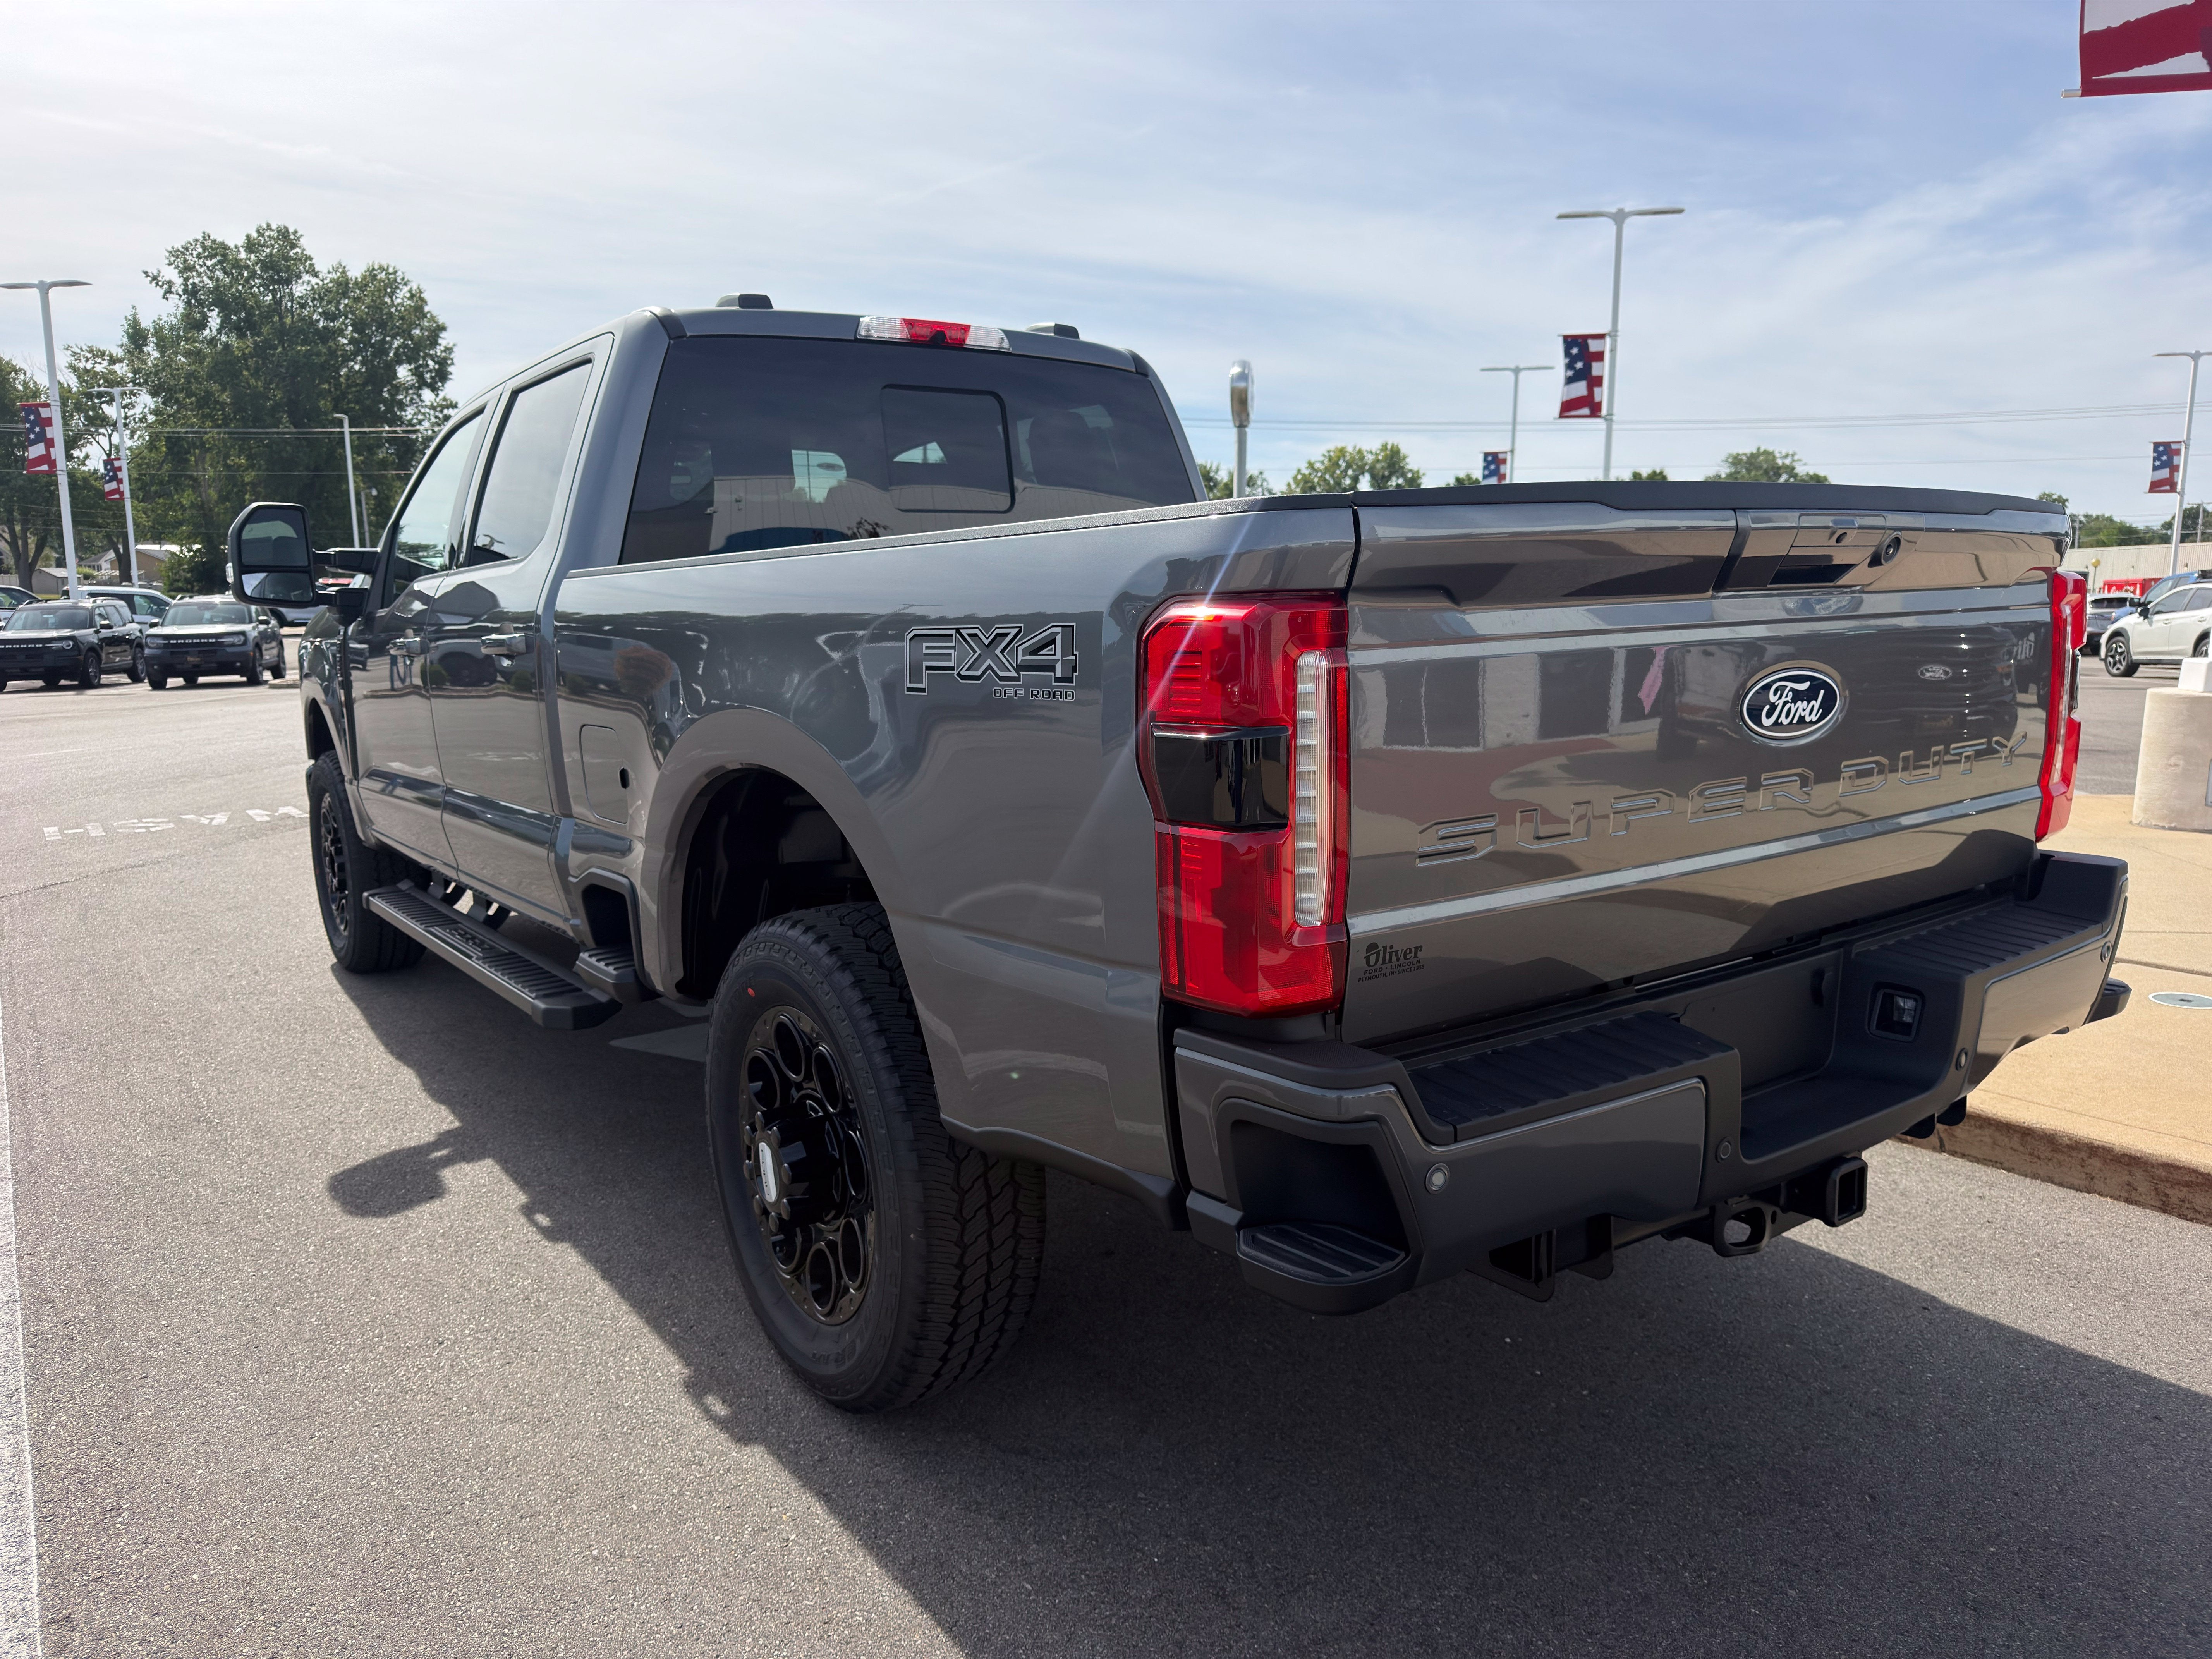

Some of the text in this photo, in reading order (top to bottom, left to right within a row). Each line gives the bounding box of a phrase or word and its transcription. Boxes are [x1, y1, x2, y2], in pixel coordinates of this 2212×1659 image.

[905, 623, 1078, 695] FX4
[993, 687, 1075, 701] OFF ROAD
[1762, 681, 1824, 726] Ford
[1415, 730, 2027, 867] SUPER DUTY
[1364, 942, 1423, 967] Oliver
[1364, 959, 1420, 975] FORD LINCOLN
[1358, 972, 1388, 982] PLYMOUTH,
